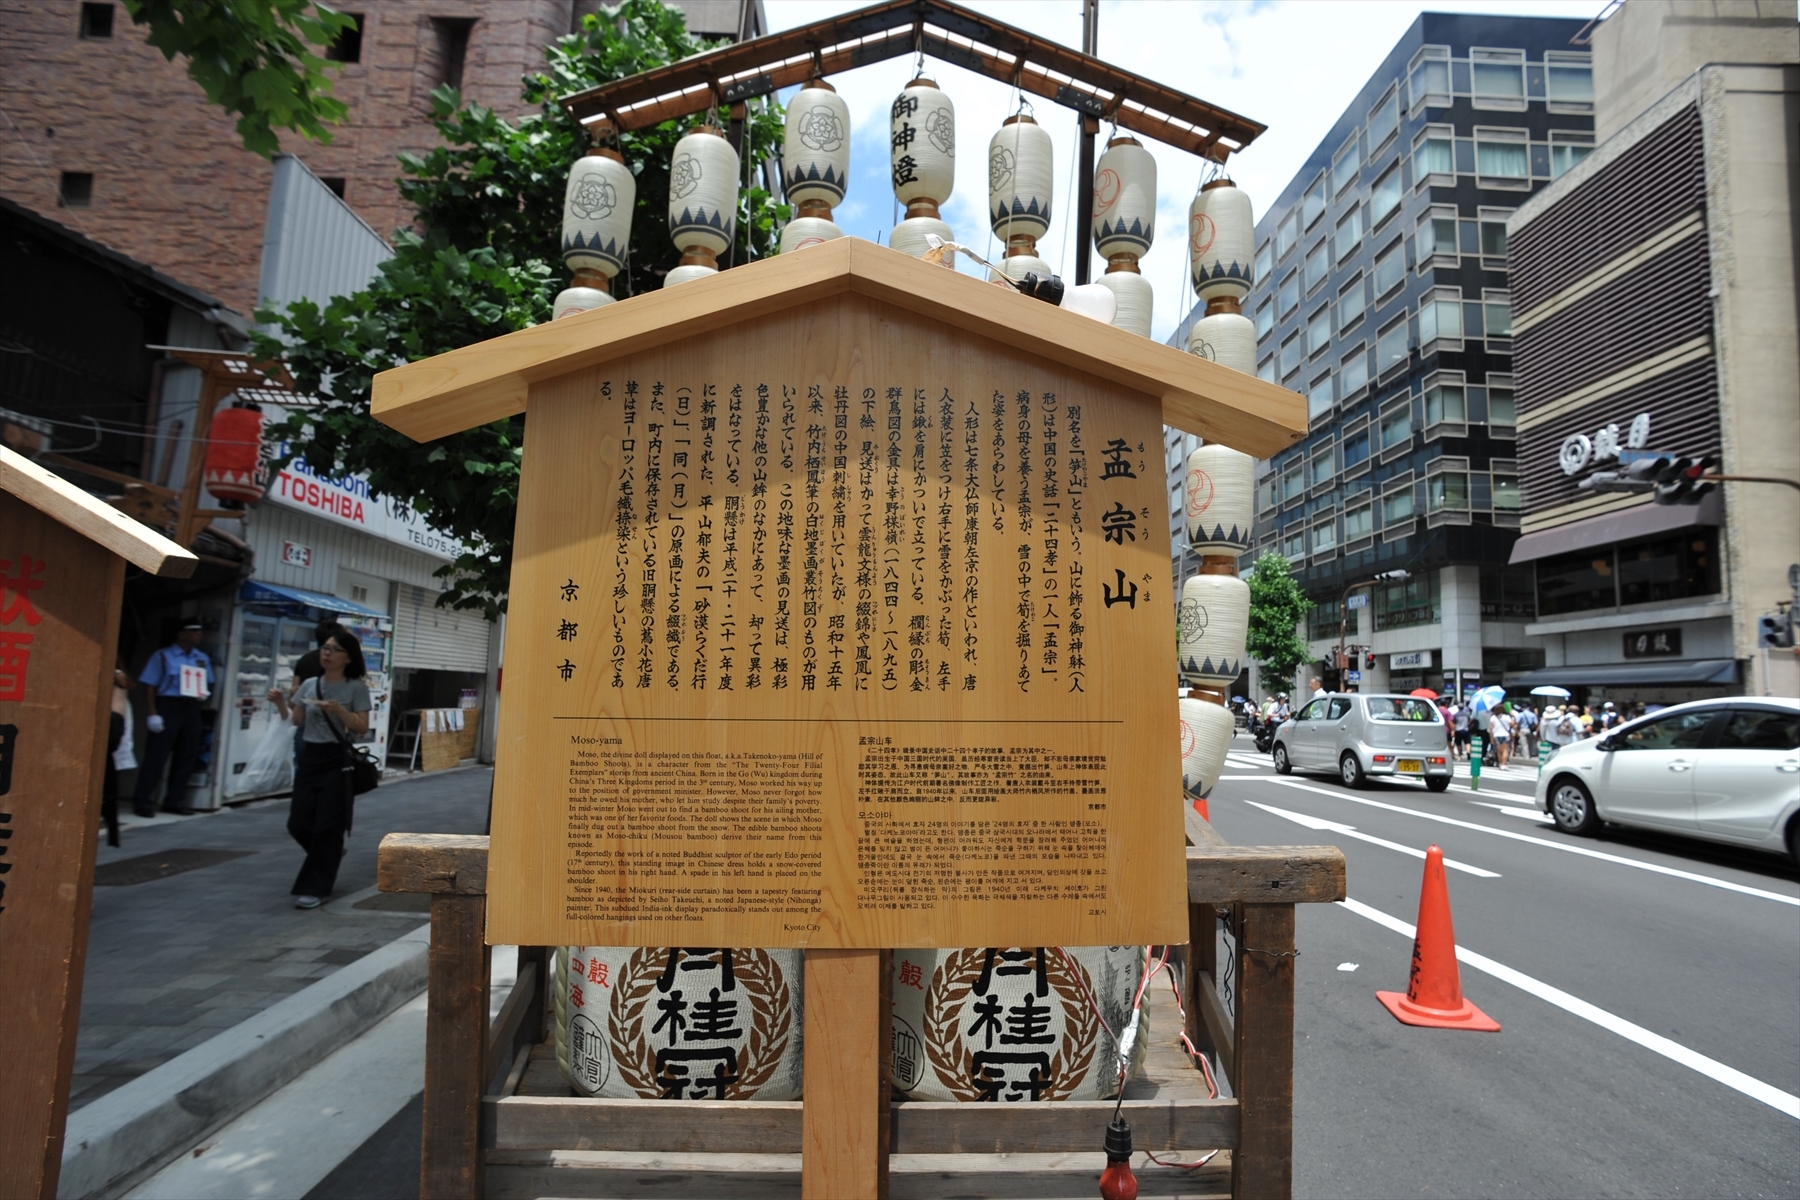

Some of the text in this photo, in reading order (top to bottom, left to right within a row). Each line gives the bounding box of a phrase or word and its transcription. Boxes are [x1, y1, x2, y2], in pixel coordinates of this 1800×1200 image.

[991, 389, 1006, 535] た姿をあらわしている。
[278, 471, 365, 524] TOSHIBA
[1099, 437, 1138, 609] 孟宗山
[556, 578, 579, 683] 京都市
[571, 736, 623, 746] Moso-yama
[858, 736, 892, 745] 孟宗山车
[577, 751, 599, 760] Moso,
[612, 751, 633, 759] divine
[634, 751, 647, 759] doll
[648, 751, 680, 761] displayed
[692, 751, 704, 759] this
[706, 752, 723, 761] float,
[798, 752, 814, 761] (Hill
[570, 759, 599, 767] Bamboo
[657, 760, 689, 768] character
[694, 760, 711, 768] from
[754, 760, 799, 770] Twenty-Four
[805, 761, 822, 769] Filial
[609, 769, 631, 777] stories
[632, 769, 649, 777] from
[650, 769, 674, 777] ancient
[675, 769, 698, 777] China.
[700, 769, 716, 777] Born
[750, 770, 768, 779] (Wu)
[769, 770, 799, 779] kingdom
[800, 770, 823, 779] during
[592, 786, 619, 796] position
[632, 787, 672, 796] government
[674, 787, 704, 795] minister.
[706, 787, 738, 796] However,
[741, 787, 761, 795] Moso
[784, 787, 805, 797] forgot
[1088, 803, 1107, 811] 京都市
[858, 811, 892, 820] 모소야마
[567, 840, 594, 849] episode.
[567, 876, 597, 884] shoulder.
[574, 885, 592, 893] Since
[596, 885, 613, 895] 1940,
[629, 886, 657, 894] Miokuri
[659, 886, 691, 895] (rear-side
[693, 886, 720, 896] curtain)
[737, 886, 752, 894] been
[762, 887, 789, 896] tapestry
[791, 887, 822, 896] featuring
[567, 895, 594, 903] bamboo
[607, 895, 635, 904] depicted
[650, 895, 670, 903] Seiho
[671, 895, 705, 905] Takeuchi,
[715, 896, 734, 904] noted
[737, 896, 785, 905] Japanese-style
[787, 896, 822, 905] (Nihonga)
[1088, 908, 1106, 916] 교토시
[566, 913, 605, 921] full-colored
[606, 913, 636, 922] hangings
[637, 913, 653, 921] used
[664, 913, 683, 921] other
[684, 913, 704, 921] floats.
[784, 923, 821, 932] Kyoto City
